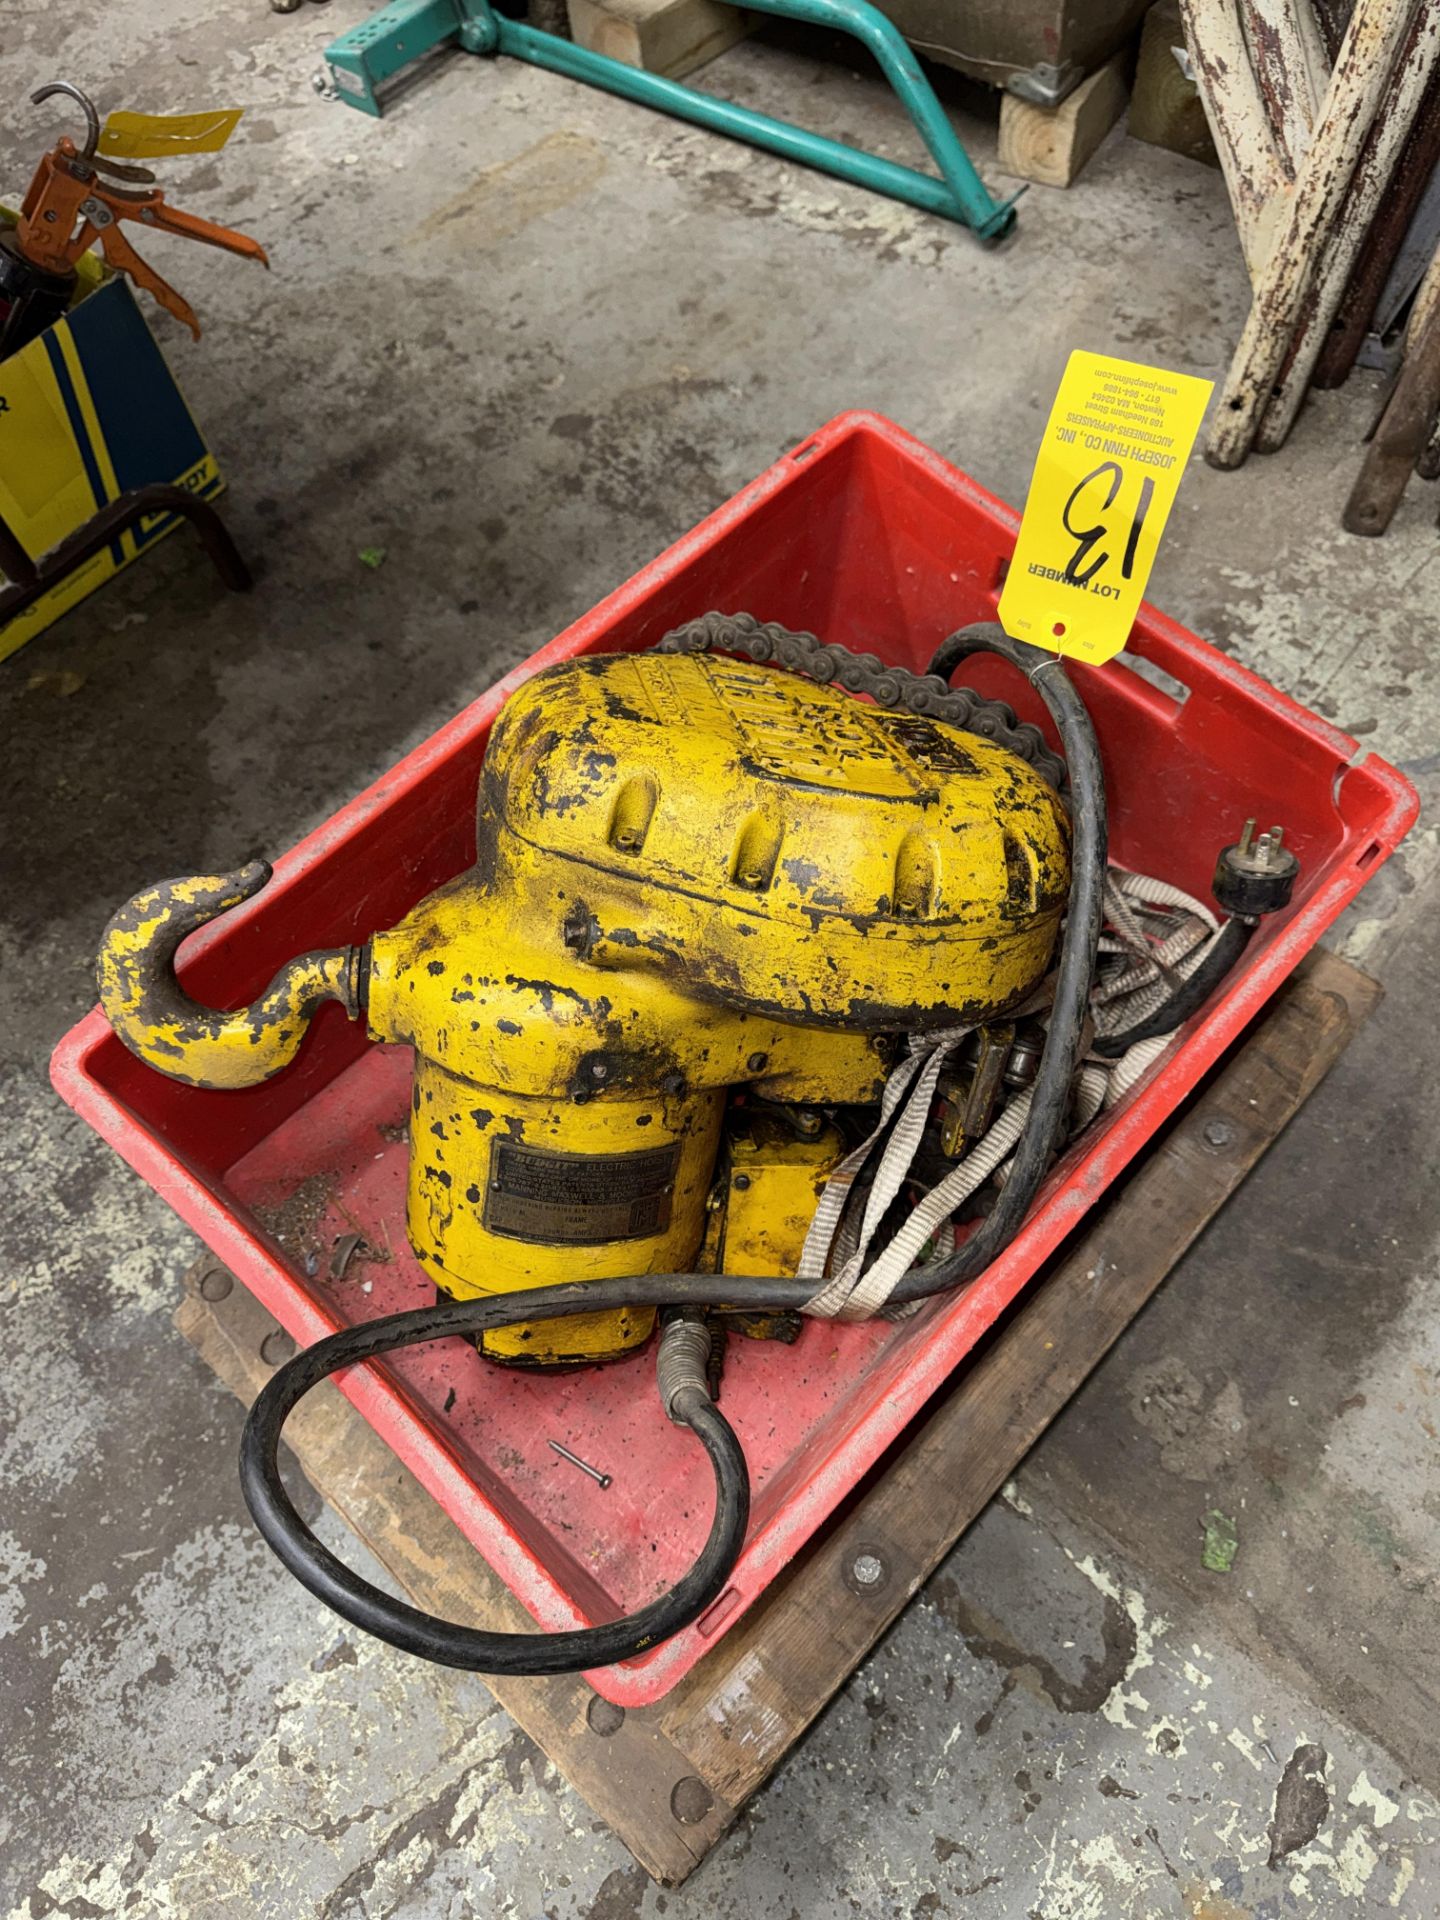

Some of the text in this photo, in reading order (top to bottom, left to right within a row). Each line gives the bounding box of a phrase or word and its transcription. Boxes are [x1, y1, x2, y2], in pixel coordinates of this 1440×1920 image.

[1085, 401, 1108, 414] Street
[1117, 398, 1132, 408] MA
[1145, 394, 1161, 403] 617
[1110, 408, 1148, 424] Needham
[1055, 426, 1076, 444] INC.
[1066, 412, 1175, 447] AUCTIONEERS-APPRAISERS
[1102, 438, 1129, 457] FINN
[1130, 447, 1177, 469] JOSEPH
[1063, 461, 1155, 585] 13
[1090, 582, 1121, 600] LOT
[585, 1159, 636, 1173] ELECTRIC
